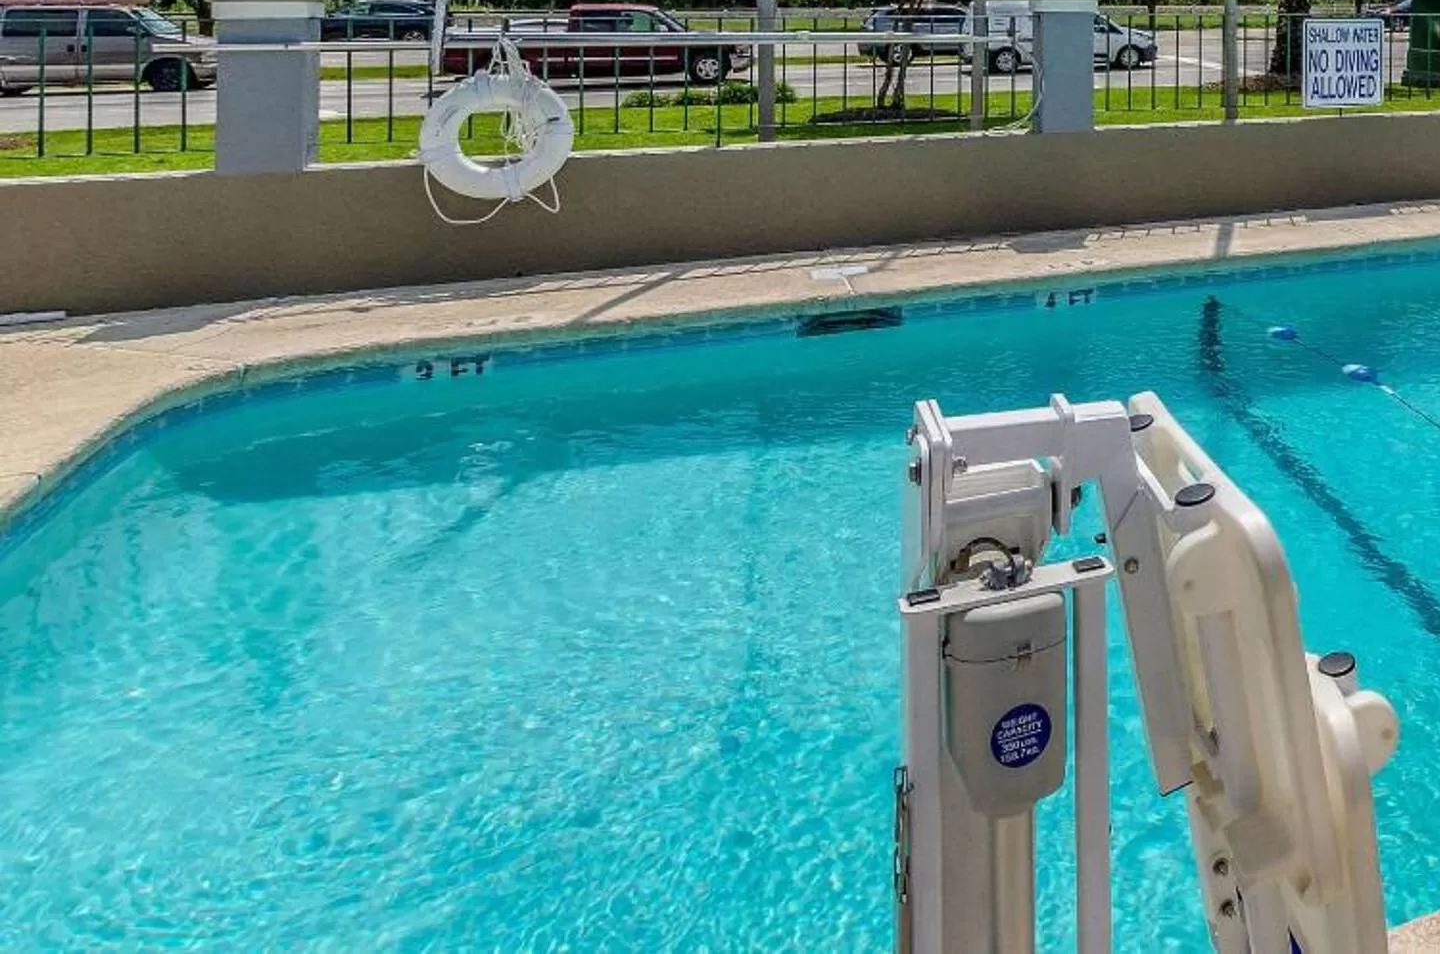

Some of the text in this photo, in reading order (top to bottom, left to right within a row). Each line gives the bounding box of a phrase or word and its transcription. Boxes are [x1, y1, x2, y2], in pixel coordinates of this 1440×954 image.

[1308, 27, 1379, 44] SHALLOW WATER
[1308, 48, 1379, 74] NO DIVING
[1310, 74, 1377, 100] ALLOWED
